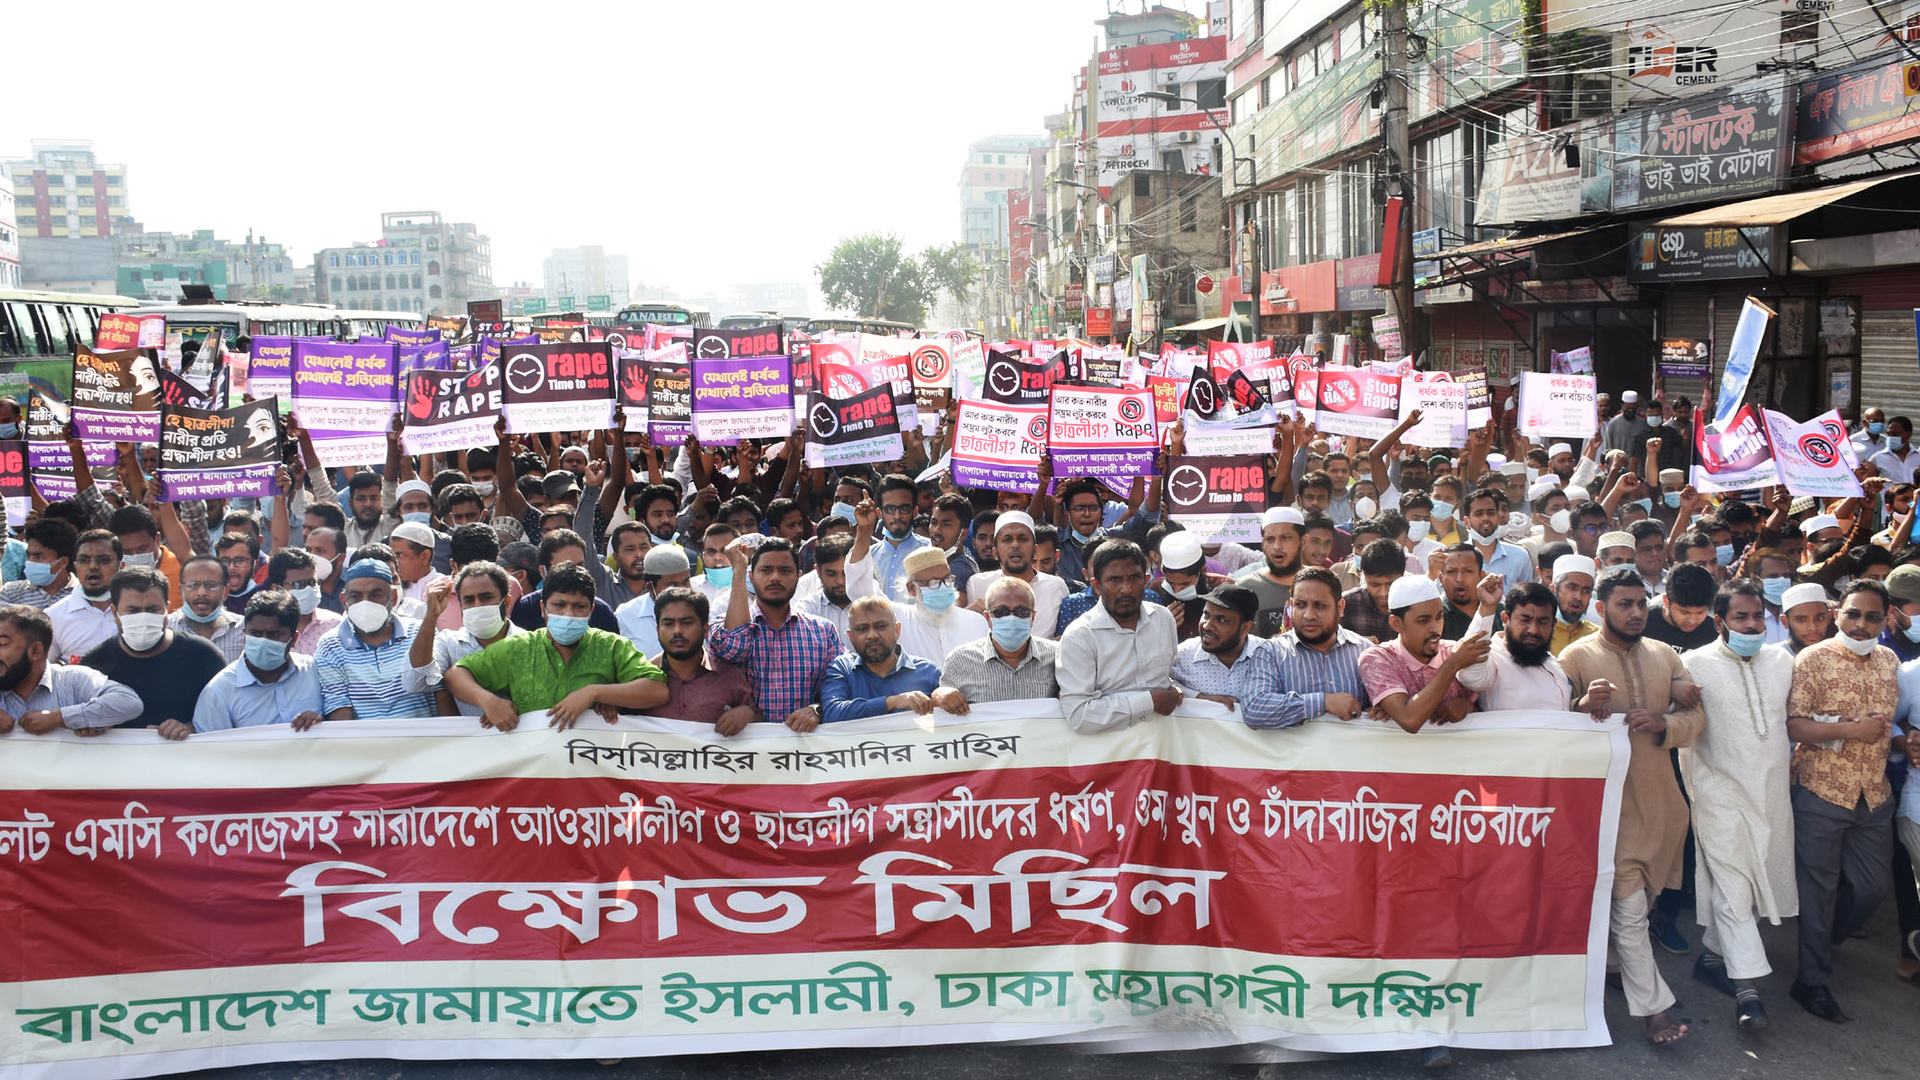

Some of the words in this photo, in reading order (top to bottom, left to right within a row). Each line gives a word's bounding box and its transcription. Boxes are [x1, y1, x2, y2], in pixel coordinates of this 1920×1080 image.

[1796, 0, 1835, 11] CEMENT
[1676, 75, 1718, 86] CEMENT
[1644, 162, 1676, 190] ভাই
[1680, 154, 1713, 184] ভাই
[1719, 146, 1775, 179] মেটাল
[1661, 232, 1684, 259] asp
[478, 323, 511, 331] STOP
[259, 347, 291, 357] যেখানে
[732, 333, 778, 356] rape
[1245, 345, 1271, 360] Stop
[304, 355, 353, 369] যেখানেই
[355, 354, 386, 369] ধর্ষক
[547, 352, 608, 379] rape
[295, 371, 343, 386] সেখানেই
[345, 372, 394, 387] প্রতিরোধ
[703, 369, 748, 385] যেখানেই
[750, 366, 780, 381] ধর্ষক
[871, 363, 908, 381] Stop
[1253, 366, 1286, 380] Stop
[438, 365, 500, 396] STOP
[548, 379, 574, 391] Time
[575, 380, 586, 389] to
[588, 378, 609, 389] stop
[666, 378, 691, 391] ছাত্রল
[1366, 378, 1398, 397] Stop
[652, 391, 679, 405] নারীর
[680, 394, 691, 405] প্র
[695, 386, 740, 401] সেখানেই
[743, 383, 789, 398] প্রতিরোধ
[1021, 389, 1042, 398] Time
[1550, 391, 1567, 400] দেশ
[1568, 390, 1594, 401] বাঁচাও
[438, 390, 502, 418] RAPE
[839, 393, 892, 424] rape
[1055, 396, 1069, 405] আর
[1071, 396, 1084, 406] কত
[1086, 395, 1107, 406] নারীর
[1363, 394, 1398, 411] Rape
[1420, 399, 1438, 409] দেশ
[1440, 398, 1464, 410] বাঁচাও
[165, 415, 182, 427] হে
[183, 415, 235, 430] ছাত্রলীগ!
[964, 410, 979, 420] আর
[980, 413, 995, 424] কত
[996, 414, 1018, 425] নারীর
[1072, 409, 1084, 420] লুট
[842, 423, 863, 434] Time
[864, 419, 874, 428] to
[875, 415, 895, 426] stop
[981, 425, 993, 435] লুট
[994, 427, 1016, 437] করবে
[1054, 418, 1109, 439] ছাত্রলীগ?
[1115, 422, 1152, 439] Rape
[163, 428, 199, 446] নারীর
[201, 433, 227, 446] প্রতি
[961, 434, 1016, 455] ছাত্রলীগ?
[161, 448, 214, 463] শ্রদ্ধাশীল
[216, 446, 241, 460] হও!
[1021, 440, 1047, 456] Rap
[1054, 453, 1088, 462] বাংলাদেশ
[1090, 454, 1125, 462] জামায়াতে
[1126, 451, 1154, 462] ইসলামী
[1067, 465, 1084, 474] ঢাকা
[1087, 464, 1118, 474] মহানগরী
[1119, 464, 1141, 474] দক্ষিণ
[1210, 466, 1264, 492] rape
[1208, 492, 1232, 503] Time
[1233, 493, 1242, 502] to
[1244, 492, 1264, 502] stop
[772, 743, 914, 772] রাহমানির
[928, 732, 1021, 761] রাহিম
[65, 800, 166, 862] এমসি
[172, 809, 344, 861] কলেজসহ
[349, 804, 500, 849] সারাদেশে
[506, 792, 705, 850] আওয়ামীলীগ
[714, 808, 740, 846] ও
[750, 793, 877, 850] ছাত্রলীগ
[1049, 781, 1125, 849] ধর্ষণ,
[1175, 791, 1220, 848] খুন
[1226, 795, 1251, 837] ও
[1260, 785, 1422, 852] চাঁদাবাজির
[1429, 788, 1557, 849] প্রতিবাদে
[278, 860, 827, 948] বিক্ষোভ
[850, 848, 1228, 936] মিছিল
[16, 988, 332, 1045] বাংলাদেশ
[348, 983, 643, 1029] জামায়াতে
[661, 961, 916, 1025] ইসলামী,
[935, 968, 1074, 1010] ঢাকা
[1084, 964, 1311, 1019] মহানগরী
[1328, 971, 1483, 1019] দক্ষিণ
